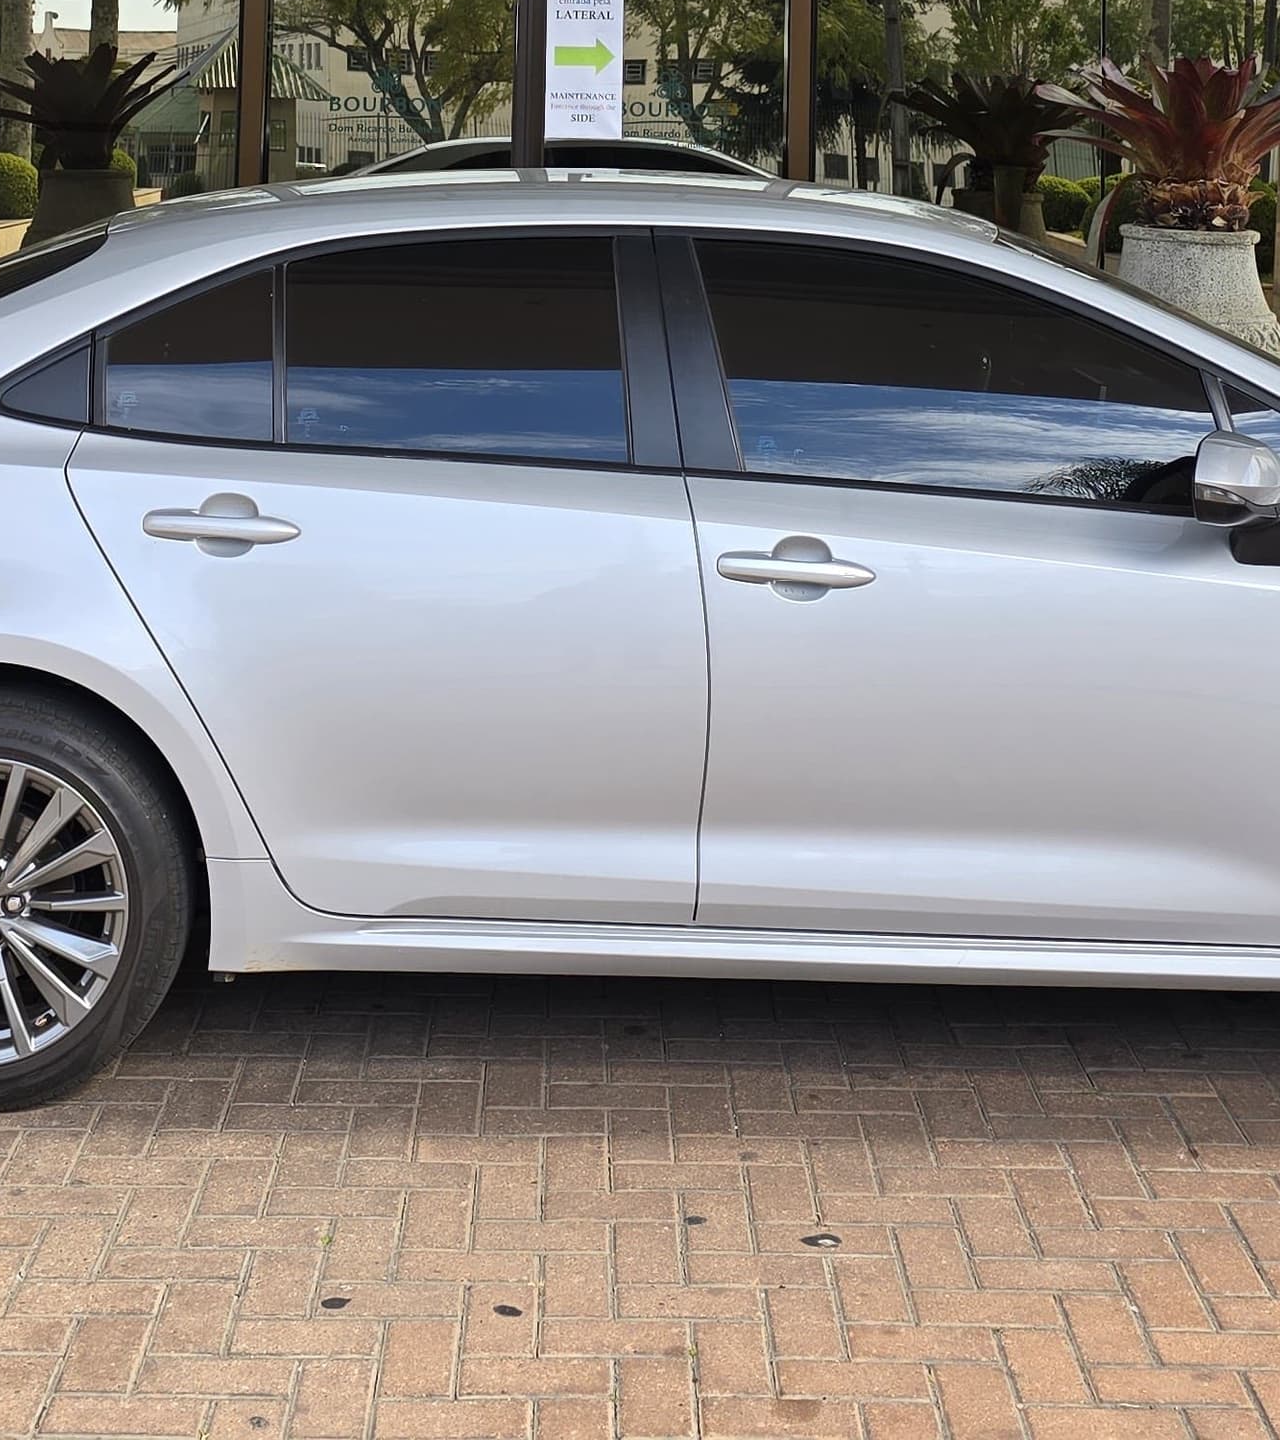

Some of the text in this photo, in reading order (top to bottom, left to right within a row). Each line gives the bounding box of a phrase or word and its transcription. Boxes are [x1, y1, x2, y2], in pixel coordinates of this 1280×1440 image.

[556, 10, 615, 21] LATERAL
[550, 91, 617, 101] MAINTENANCE
[570, 113, 596, 123] SIDE
[328, 123, 354, 133] Dom
[623, 129, 640, 138] om
[642, 128, 681, 138] Ricardo
